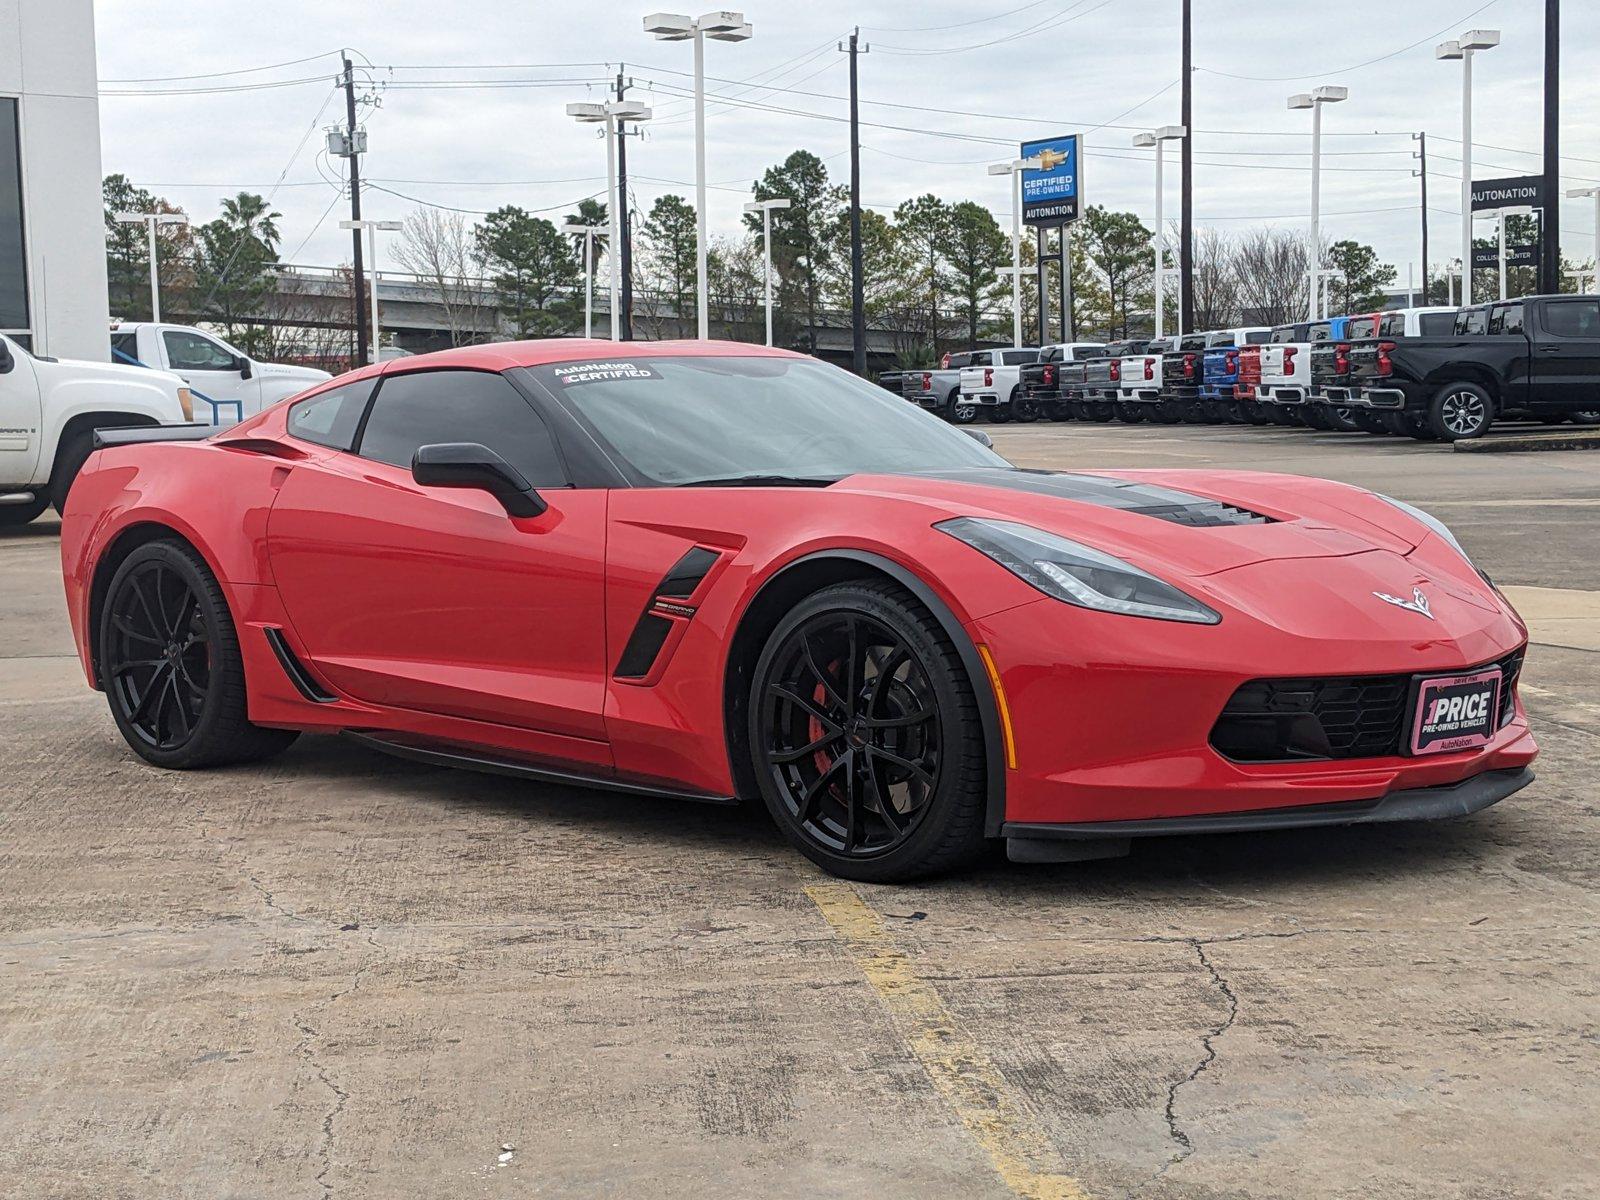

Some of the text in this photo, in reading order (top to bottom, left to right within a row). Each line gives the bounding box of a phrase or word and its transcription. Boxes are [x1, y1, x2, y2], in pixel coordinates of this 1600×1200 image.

[1024, 175, 1073, 189] CERTIFIED
[1026, 184, 1070, 196] PRE-OWNED
[1471, 187, 1537, 202] AUTONATION
[1026, 205, 1073, 219] AUTONATION
[554, 363, 637, 376] AutoNation
[568, 370, 652, 383] CERTIFIED
[1424, 691, 1491, 725] 1PRICE
[1422, 717, 1486, 733] PRE-OWNED VEHICLES
[1440, 738, 1473, 749] AutoNation
